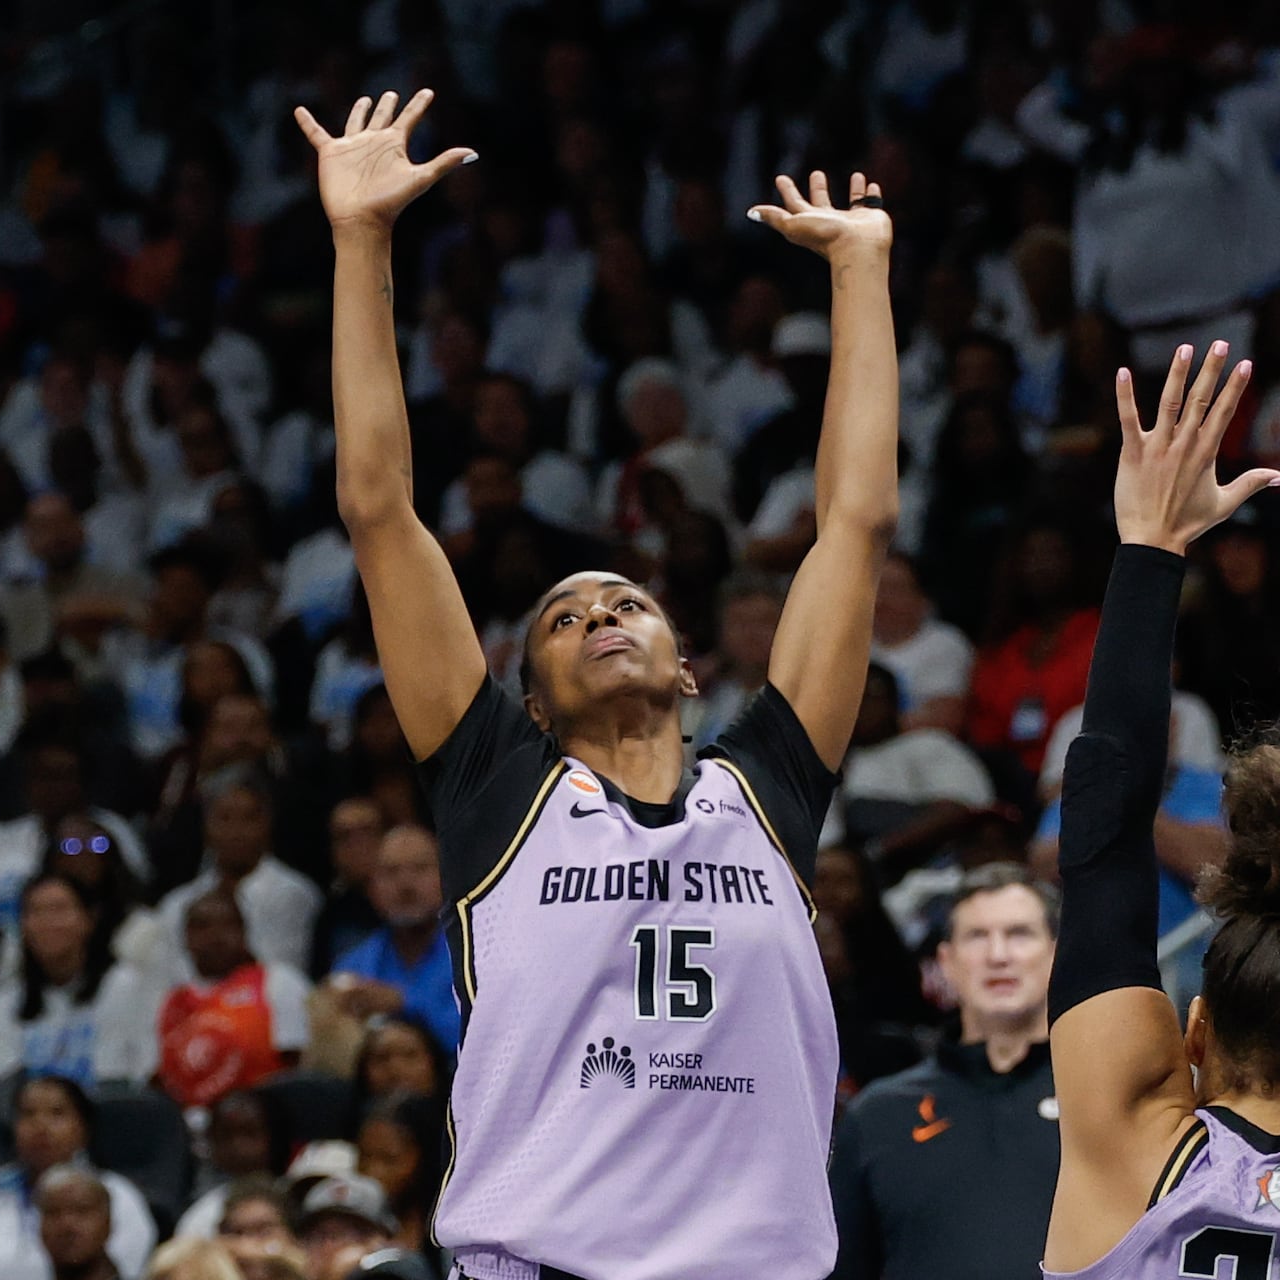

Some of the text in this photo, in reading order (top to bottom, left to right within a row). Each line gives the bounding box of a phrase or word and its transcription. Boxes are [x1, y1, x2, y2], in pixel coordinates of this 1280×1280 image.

[539, 858, 773, 906] GOLDEN STATE
[629, 923, 718, 1022] 15
[648, 1052, 704, 1070] KAISER
[648, 1073, 756, 1095] PERMANENTE
